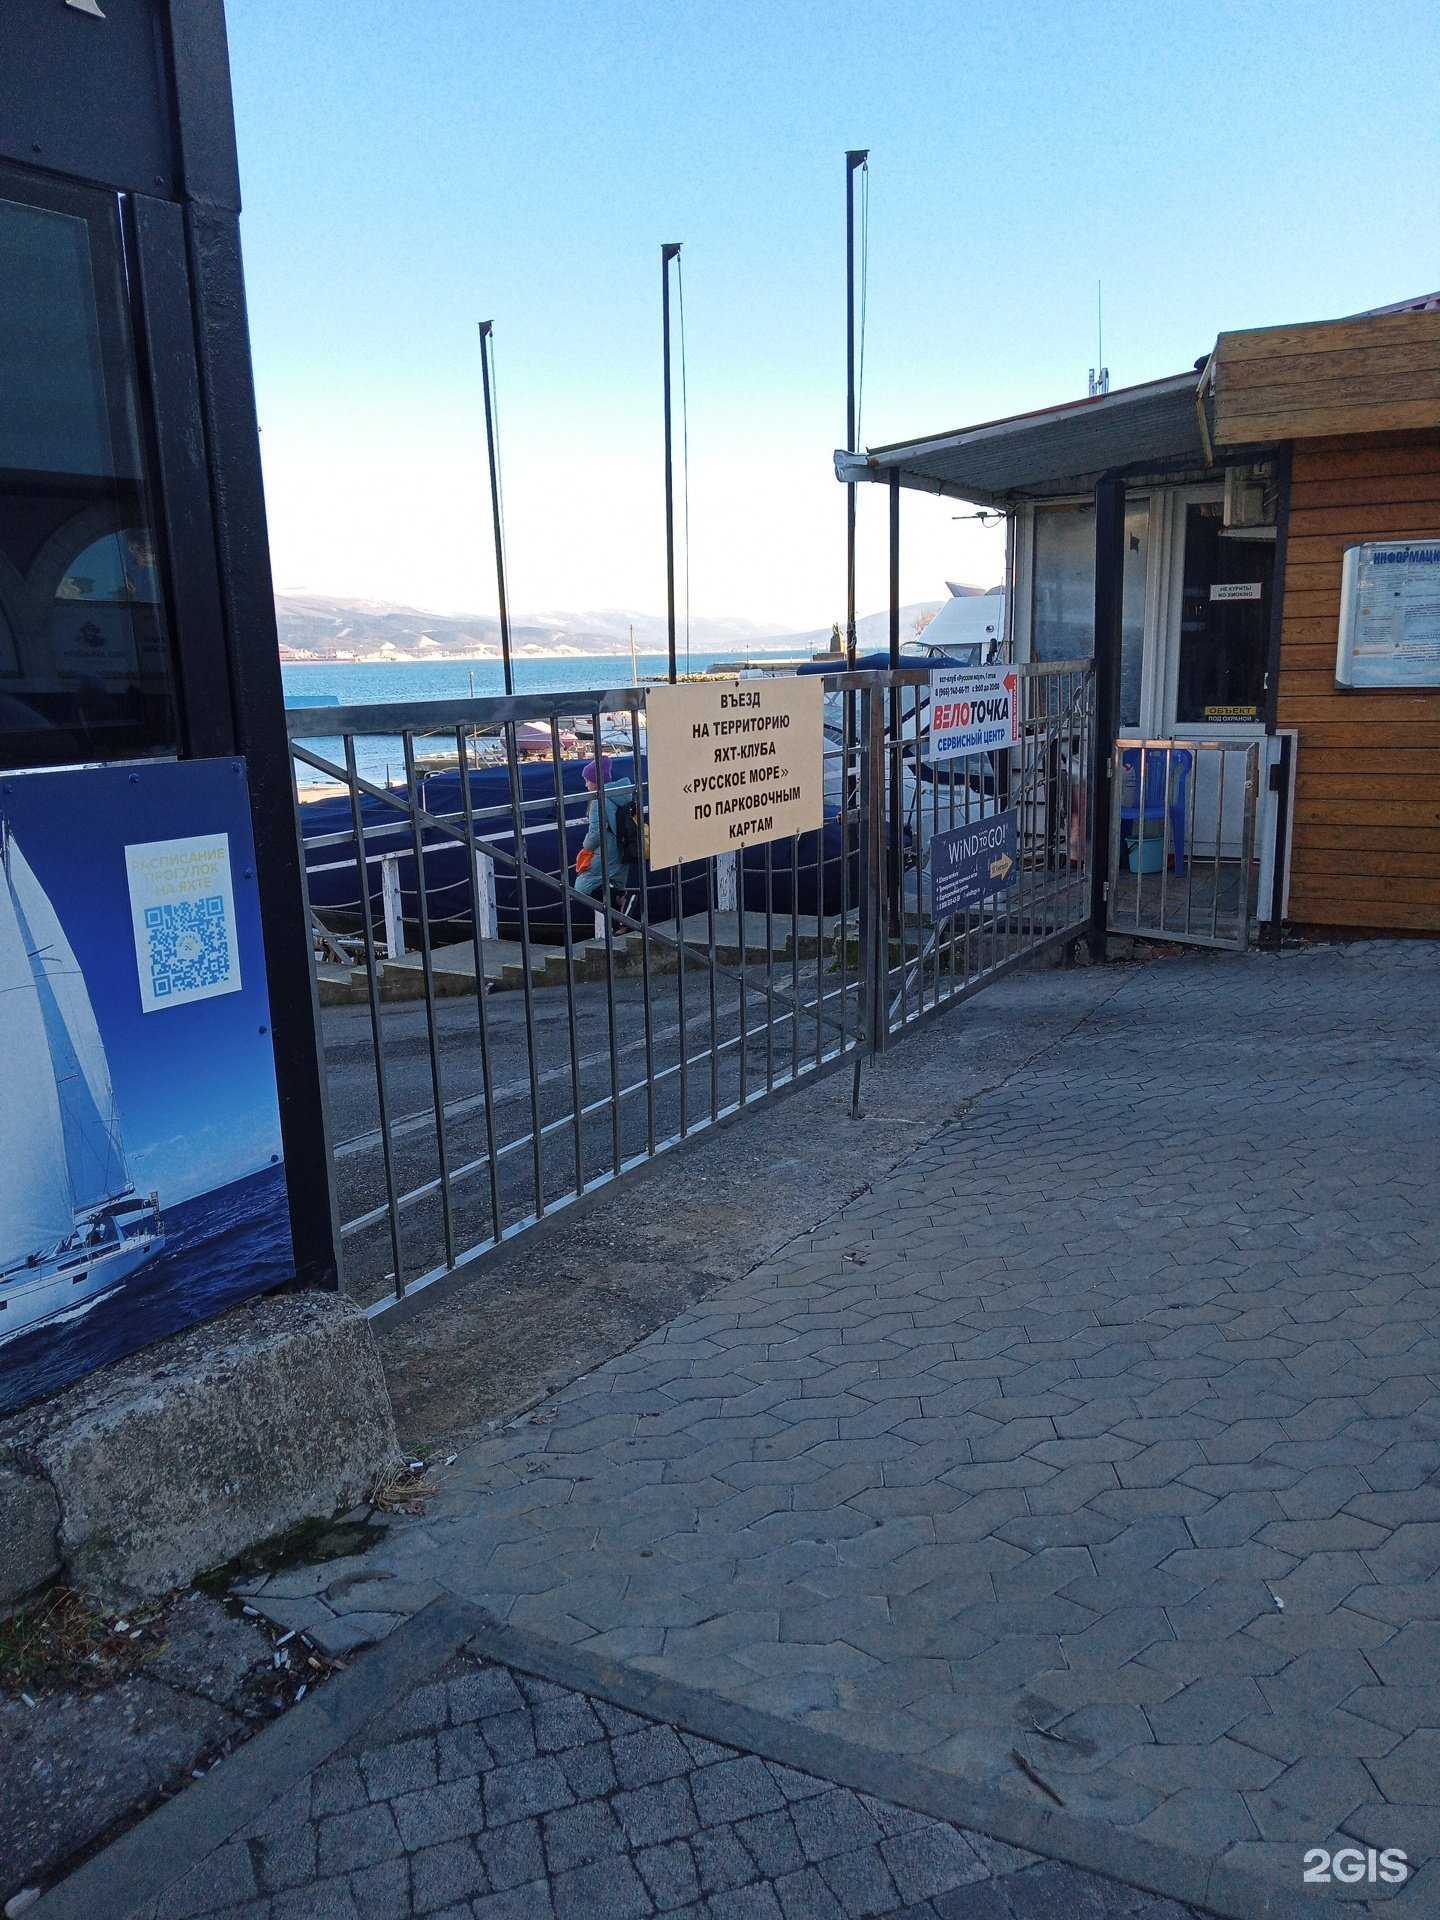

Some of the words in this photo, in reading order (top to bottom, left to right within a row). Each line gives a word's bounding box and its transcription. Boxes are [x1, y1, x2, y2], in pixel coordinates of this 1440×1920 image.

[720, 692, 761, 708] ВЪЕЗД
[934, 698, 1009, 730] ВЕЛОТОЧКА
[692, 723, 710, 739] НА
[713, 714, 790, 737] ТЕРРИТОРИЮ
[714, 741, 776, 763] ЯХТ-КЛУБА
[937, 729, 983, 752] СЕРВИСНЫЙ
[983, 729, 1005, 744] ЦЕНТР
[682, 771, 746, 794] «РУССКОЕ
[749, 765, 789, 782] МОРЕ»
[694, 804, 711, 820] ПО
[715, 786, 801, 816] ПАРКОВОЧНЫМ
[729, 816, 773, 839] КАРТАМ
[131, 847, 226, 870] РАСПИСАНИЕ
[145, 863, 219, 883] ПРОГУЛОК
[156, 884, 175, 896] НА
[179, 879, 213, 894] ЯХТЕ
